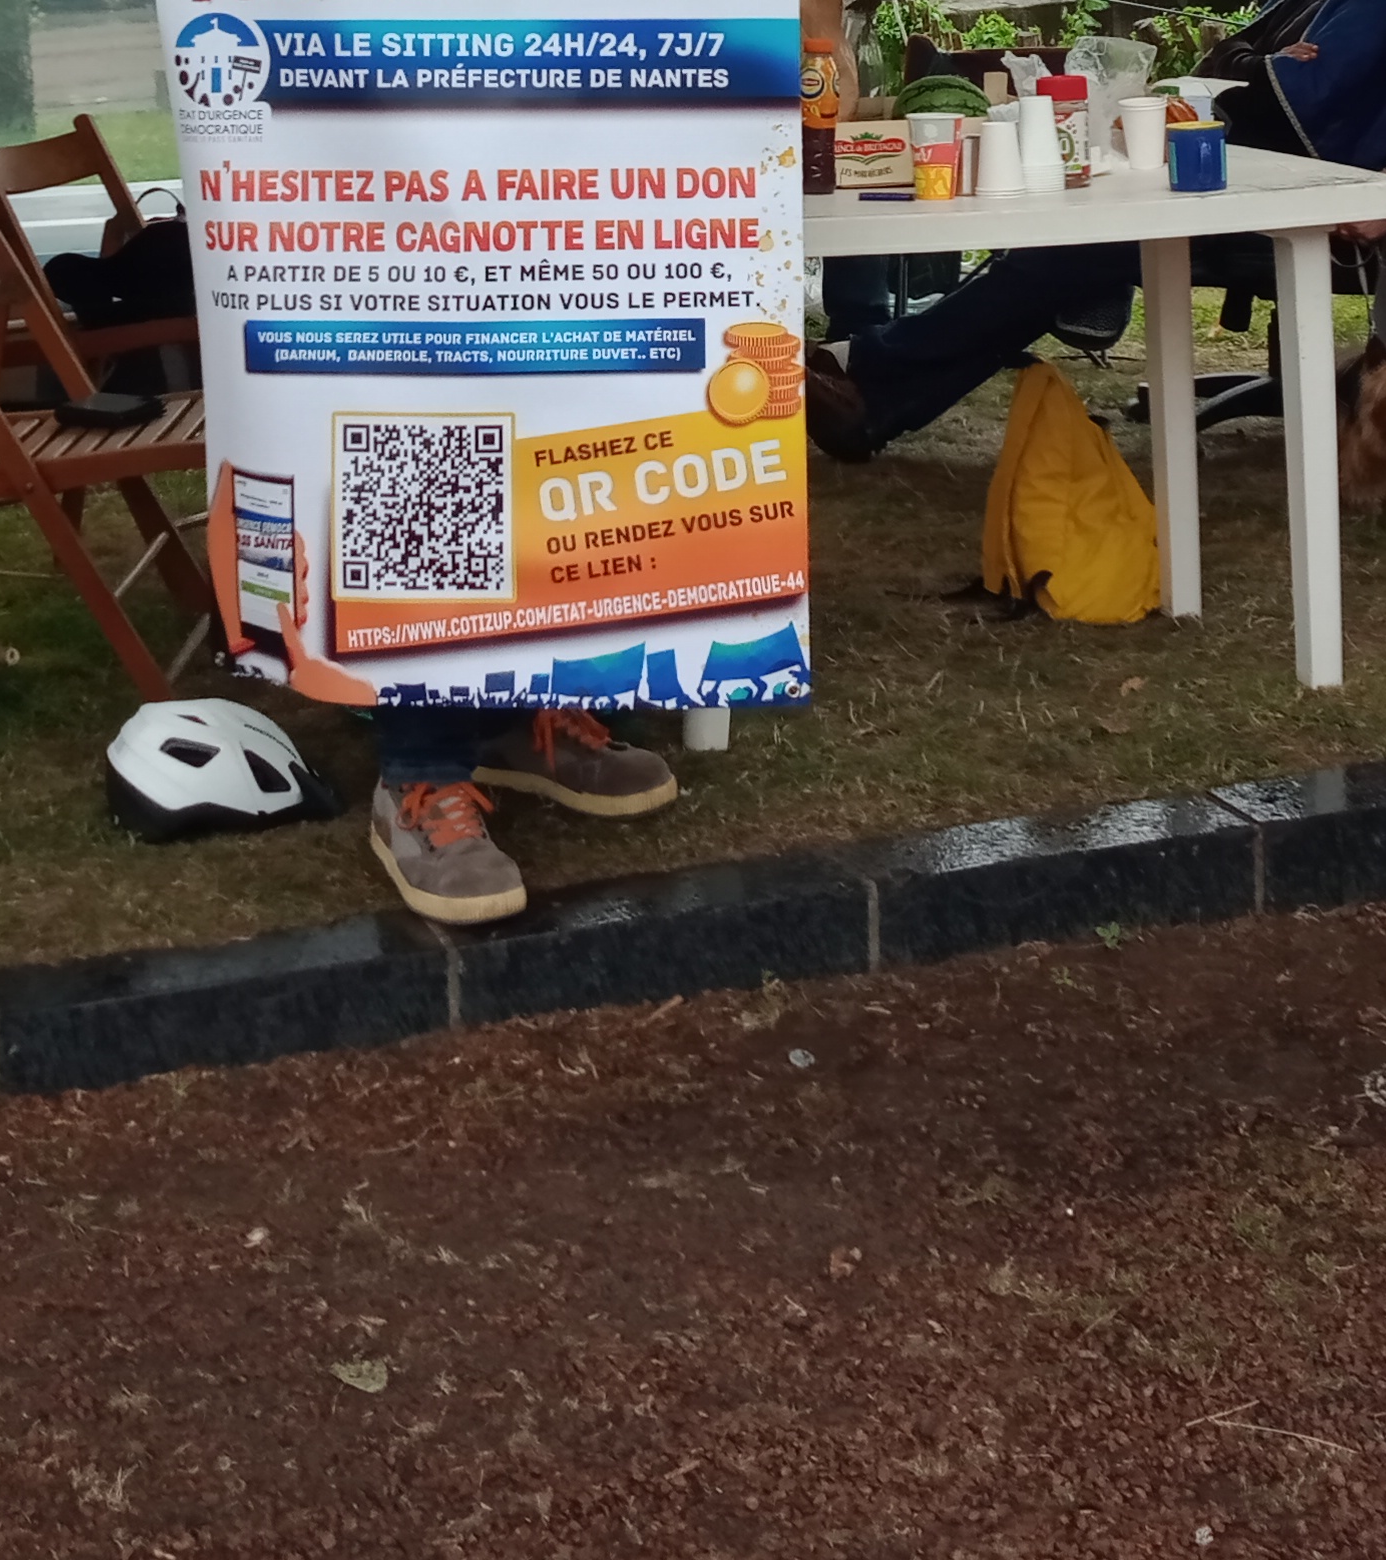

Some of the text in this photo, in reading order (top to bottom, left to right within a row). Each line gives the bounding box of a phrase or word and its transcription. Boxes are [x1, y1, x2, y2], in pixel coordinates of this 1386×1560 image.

[274, 32, 725, 61] VIA LE SITTING 24H/24, 7J/7
[280, 63, 729, 88] DEVANT LA PRÉFECTURE DE NANTES
[198, 109, 264, 120] D'URGENCE
[200, 160, 756, 202] N'HESITEZ PAS A FAIRE UN DON
[204, 218, 759, 253] SUR NOTRE CAGNOTTE EN LIGNE
[227, 266, 238, 282] A
[244, 266, 325, 282] PARTIR
[334, 266, 361, 282] DE
[368, 266, 379, 282] 5
[388, 266, 415, 282] OU
[424, 266, 446, 282] 10
[484, 265, 512, 281] ET
[520, 259, 585, 281] MÊME
[592, 263, 619, 280] 50
[627, 263, 655, 280] OU
[665, 263, 702, 279] 100
[212, 290, 760, 311] VOIR PLUS SI VOTRE SITUATION VOUS LE PERMET.
[258, 327, 696, 345] VOUS NOUS SEREZ UTILE POUR FINANCER L'ACHAT DE MATÉRIEL
[275, 347, 681, 364] (BARNUM, BANDEROLE, TRACTS, NOURRITURE DUVET.. ETC)
[534, 430, 674, 467] FLASHEZ CE
[539, 438, 787, 522] QR CODE
[547, 501, 795, 555] OU RENDEZ VOUS SUR
[550, 563, 581, 584] CE
[587, 555, 642, 579] LIEN
[346, 570, 805, 649] HTTPS://WWW.COTIZUP.COM/ETAT-URGENCE-DEMOCRATIQUE-44
